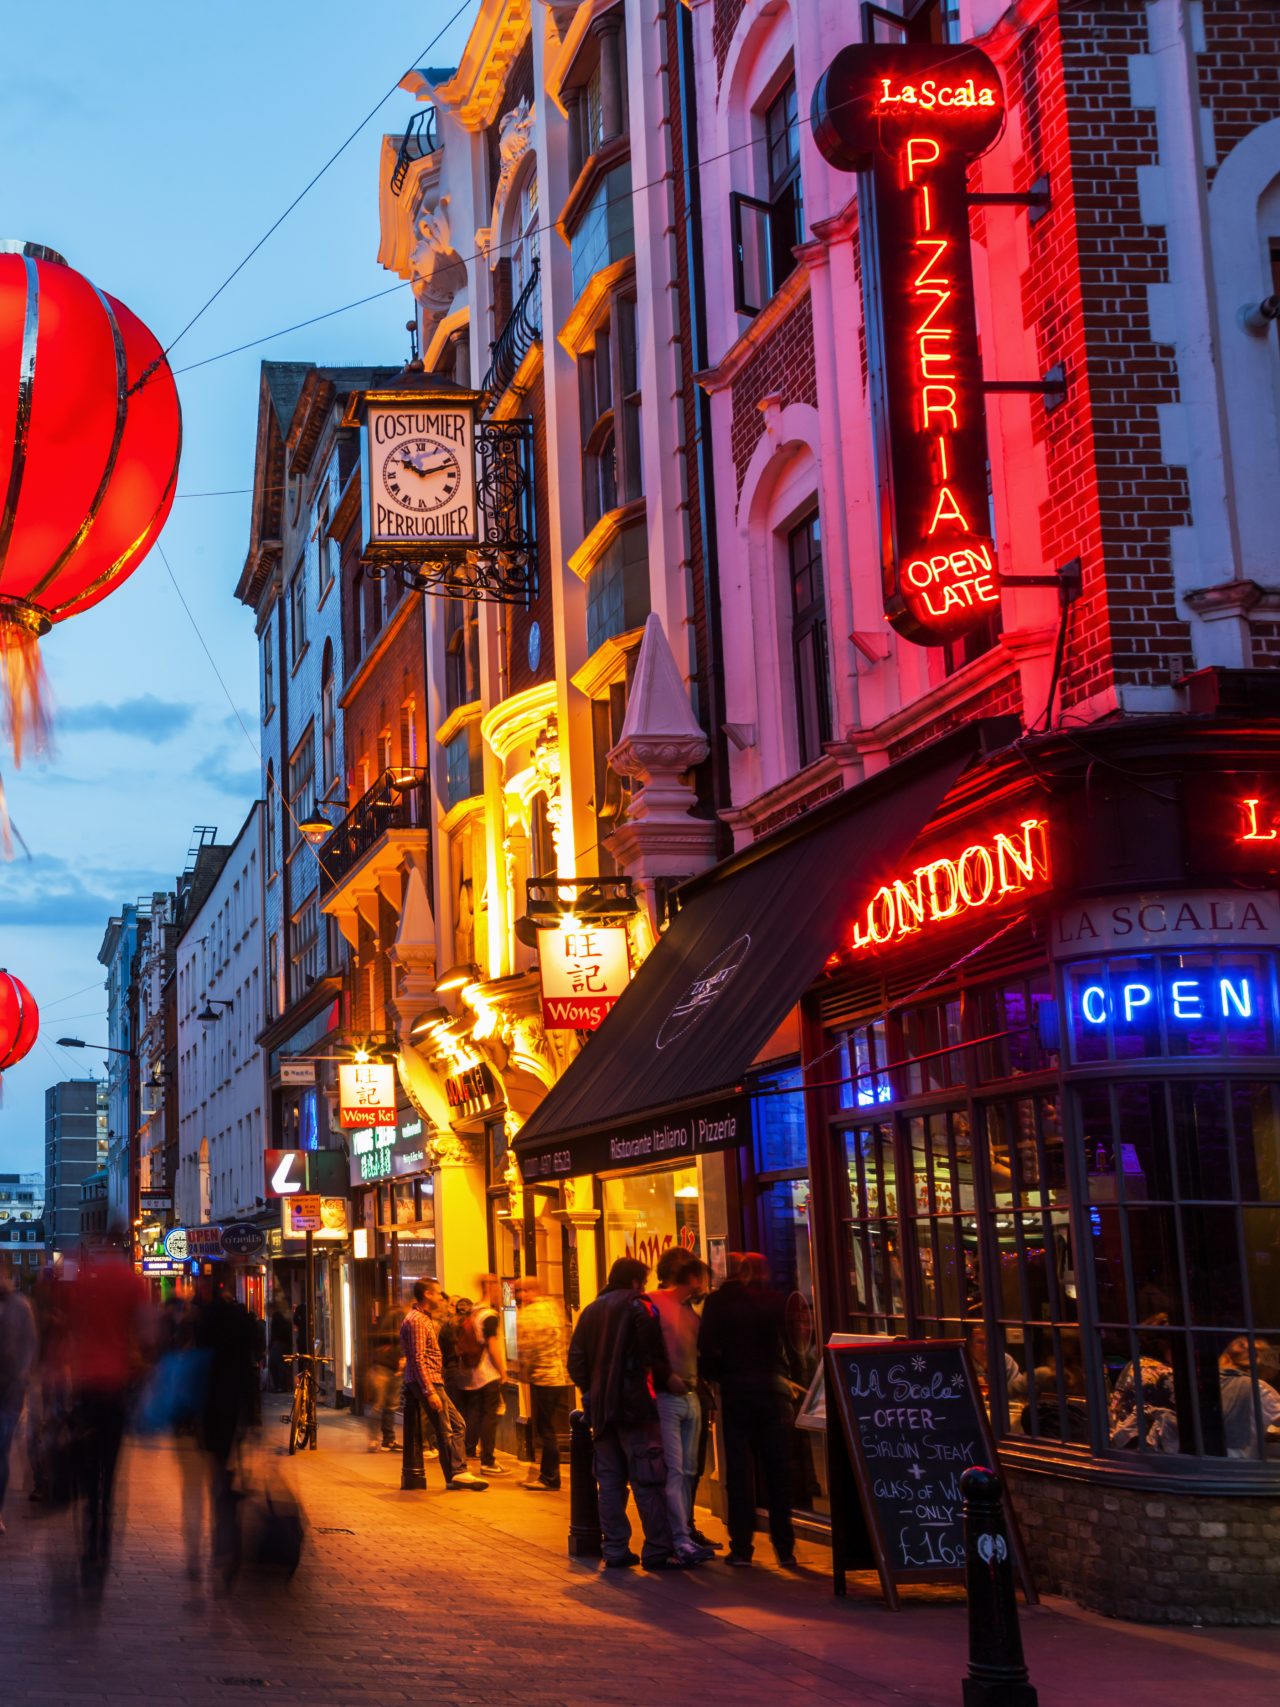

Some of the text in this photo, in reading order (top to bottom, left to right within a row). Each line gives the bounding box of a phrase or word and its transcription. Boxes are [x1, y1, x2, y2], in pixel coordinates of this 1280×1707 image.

[907, 138, 968, 534] PIZZERIA
[375, 414, 465, 447] COSTUMIER
[377, 503, 469, 537] PERRUQUIER
[908, 545, 992, 587] OPEN
[921, 575, 999, 615] LATE
[851, 818, 1045, 949] LONDON
[1058, 901, 1270, 944] LA SCALA
[564, 932, 608, 993] 旺記
[547, 1001, 601, 1026] Wong
[1082, 978, 1252, 1024] OPEN
[343, 1109, 394, 1125] Wong Kei
[610, 1113, 736, 1160] Ristorante Italiano Pizzeria
[188, 1227, 219, 1243] OPEN
[874, 1408, 937, 1430] OFFER
[923, 1434, 975, 1464] STEAK
[873, 1478, 914, 1501] GLASS
[915, 1504, 954, 1522] ONLY
